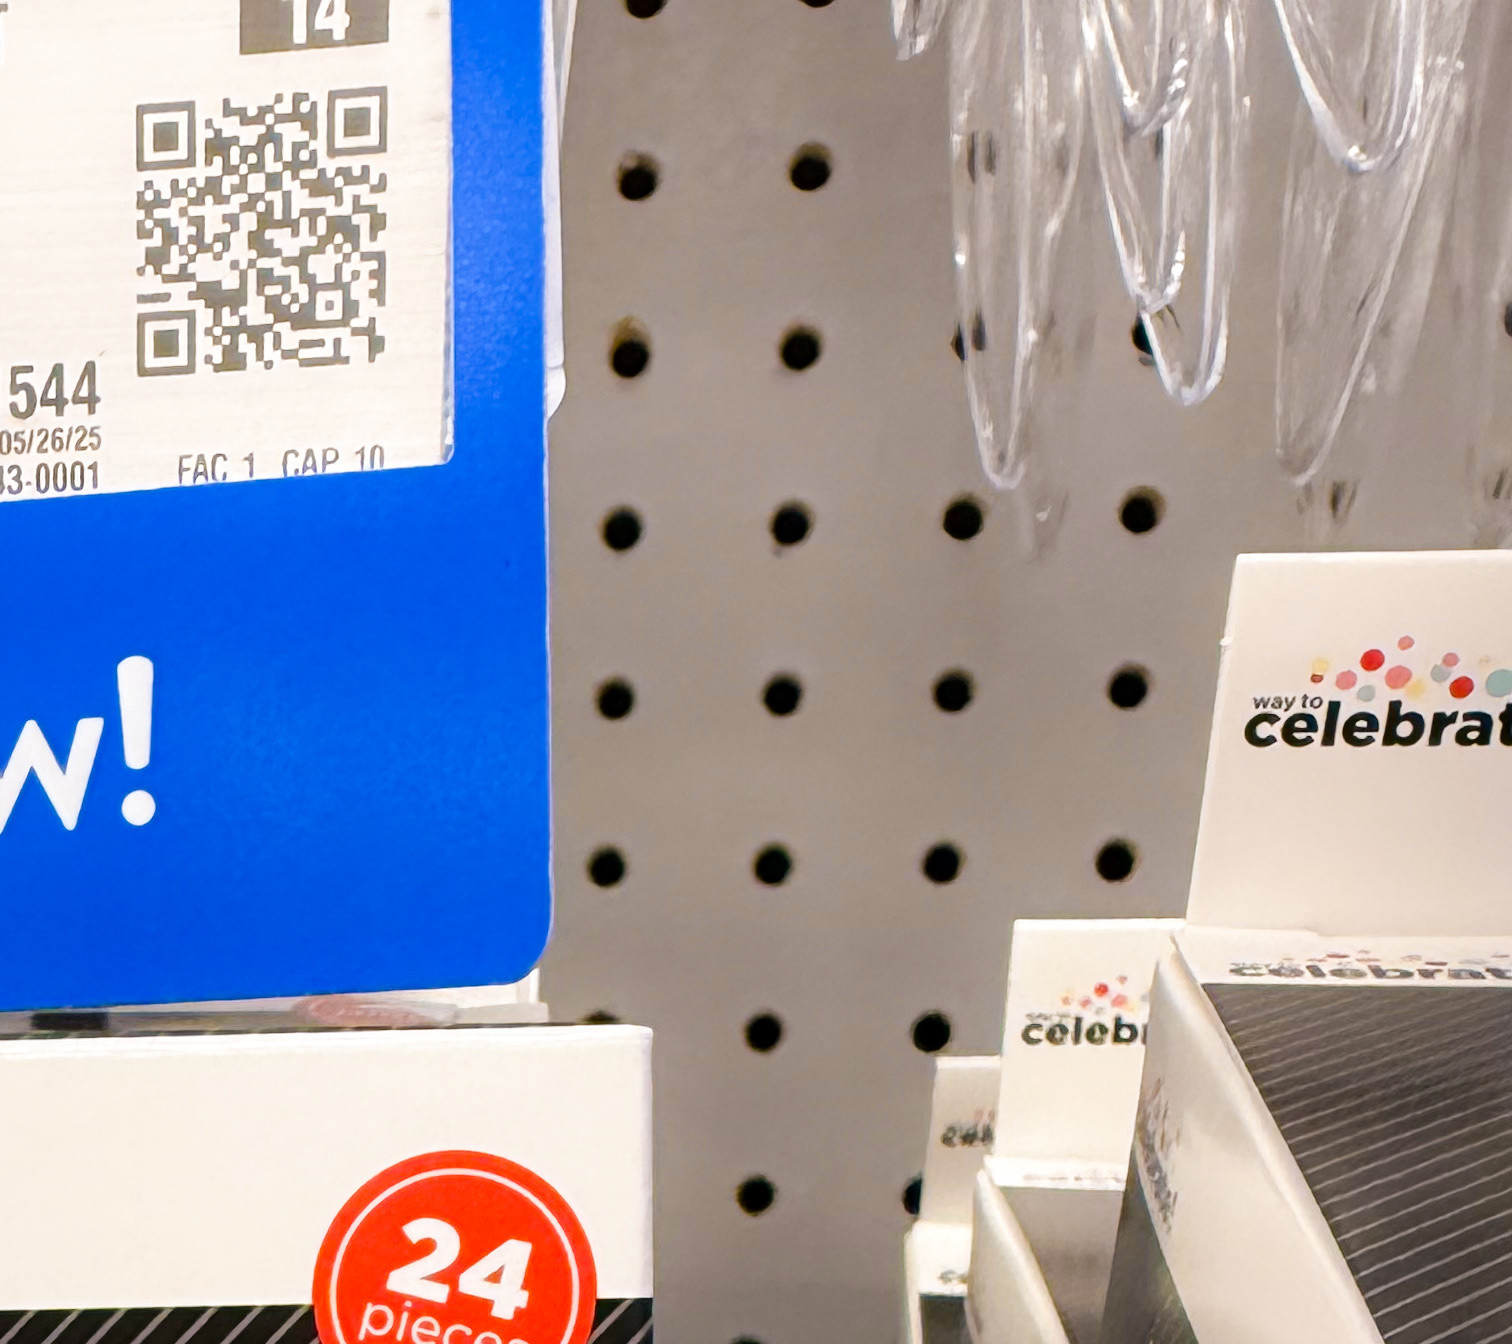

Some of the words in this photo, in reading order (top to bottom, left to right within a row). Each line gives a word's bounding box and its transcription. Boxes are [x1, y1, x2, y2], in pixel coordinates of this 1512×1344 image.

[178, 453, 228, 486] FAC
[243, 452, 255, 479] 1
[281, 447, 340, 478] CAP
[354, 444, 385, 471] 10
[1244, 700, 1512, 748] celebrat
[1253, 695, 1296, 712] way
[1301, 693, 1323, 709] to
[386, 1217, 532, 1320] 24
